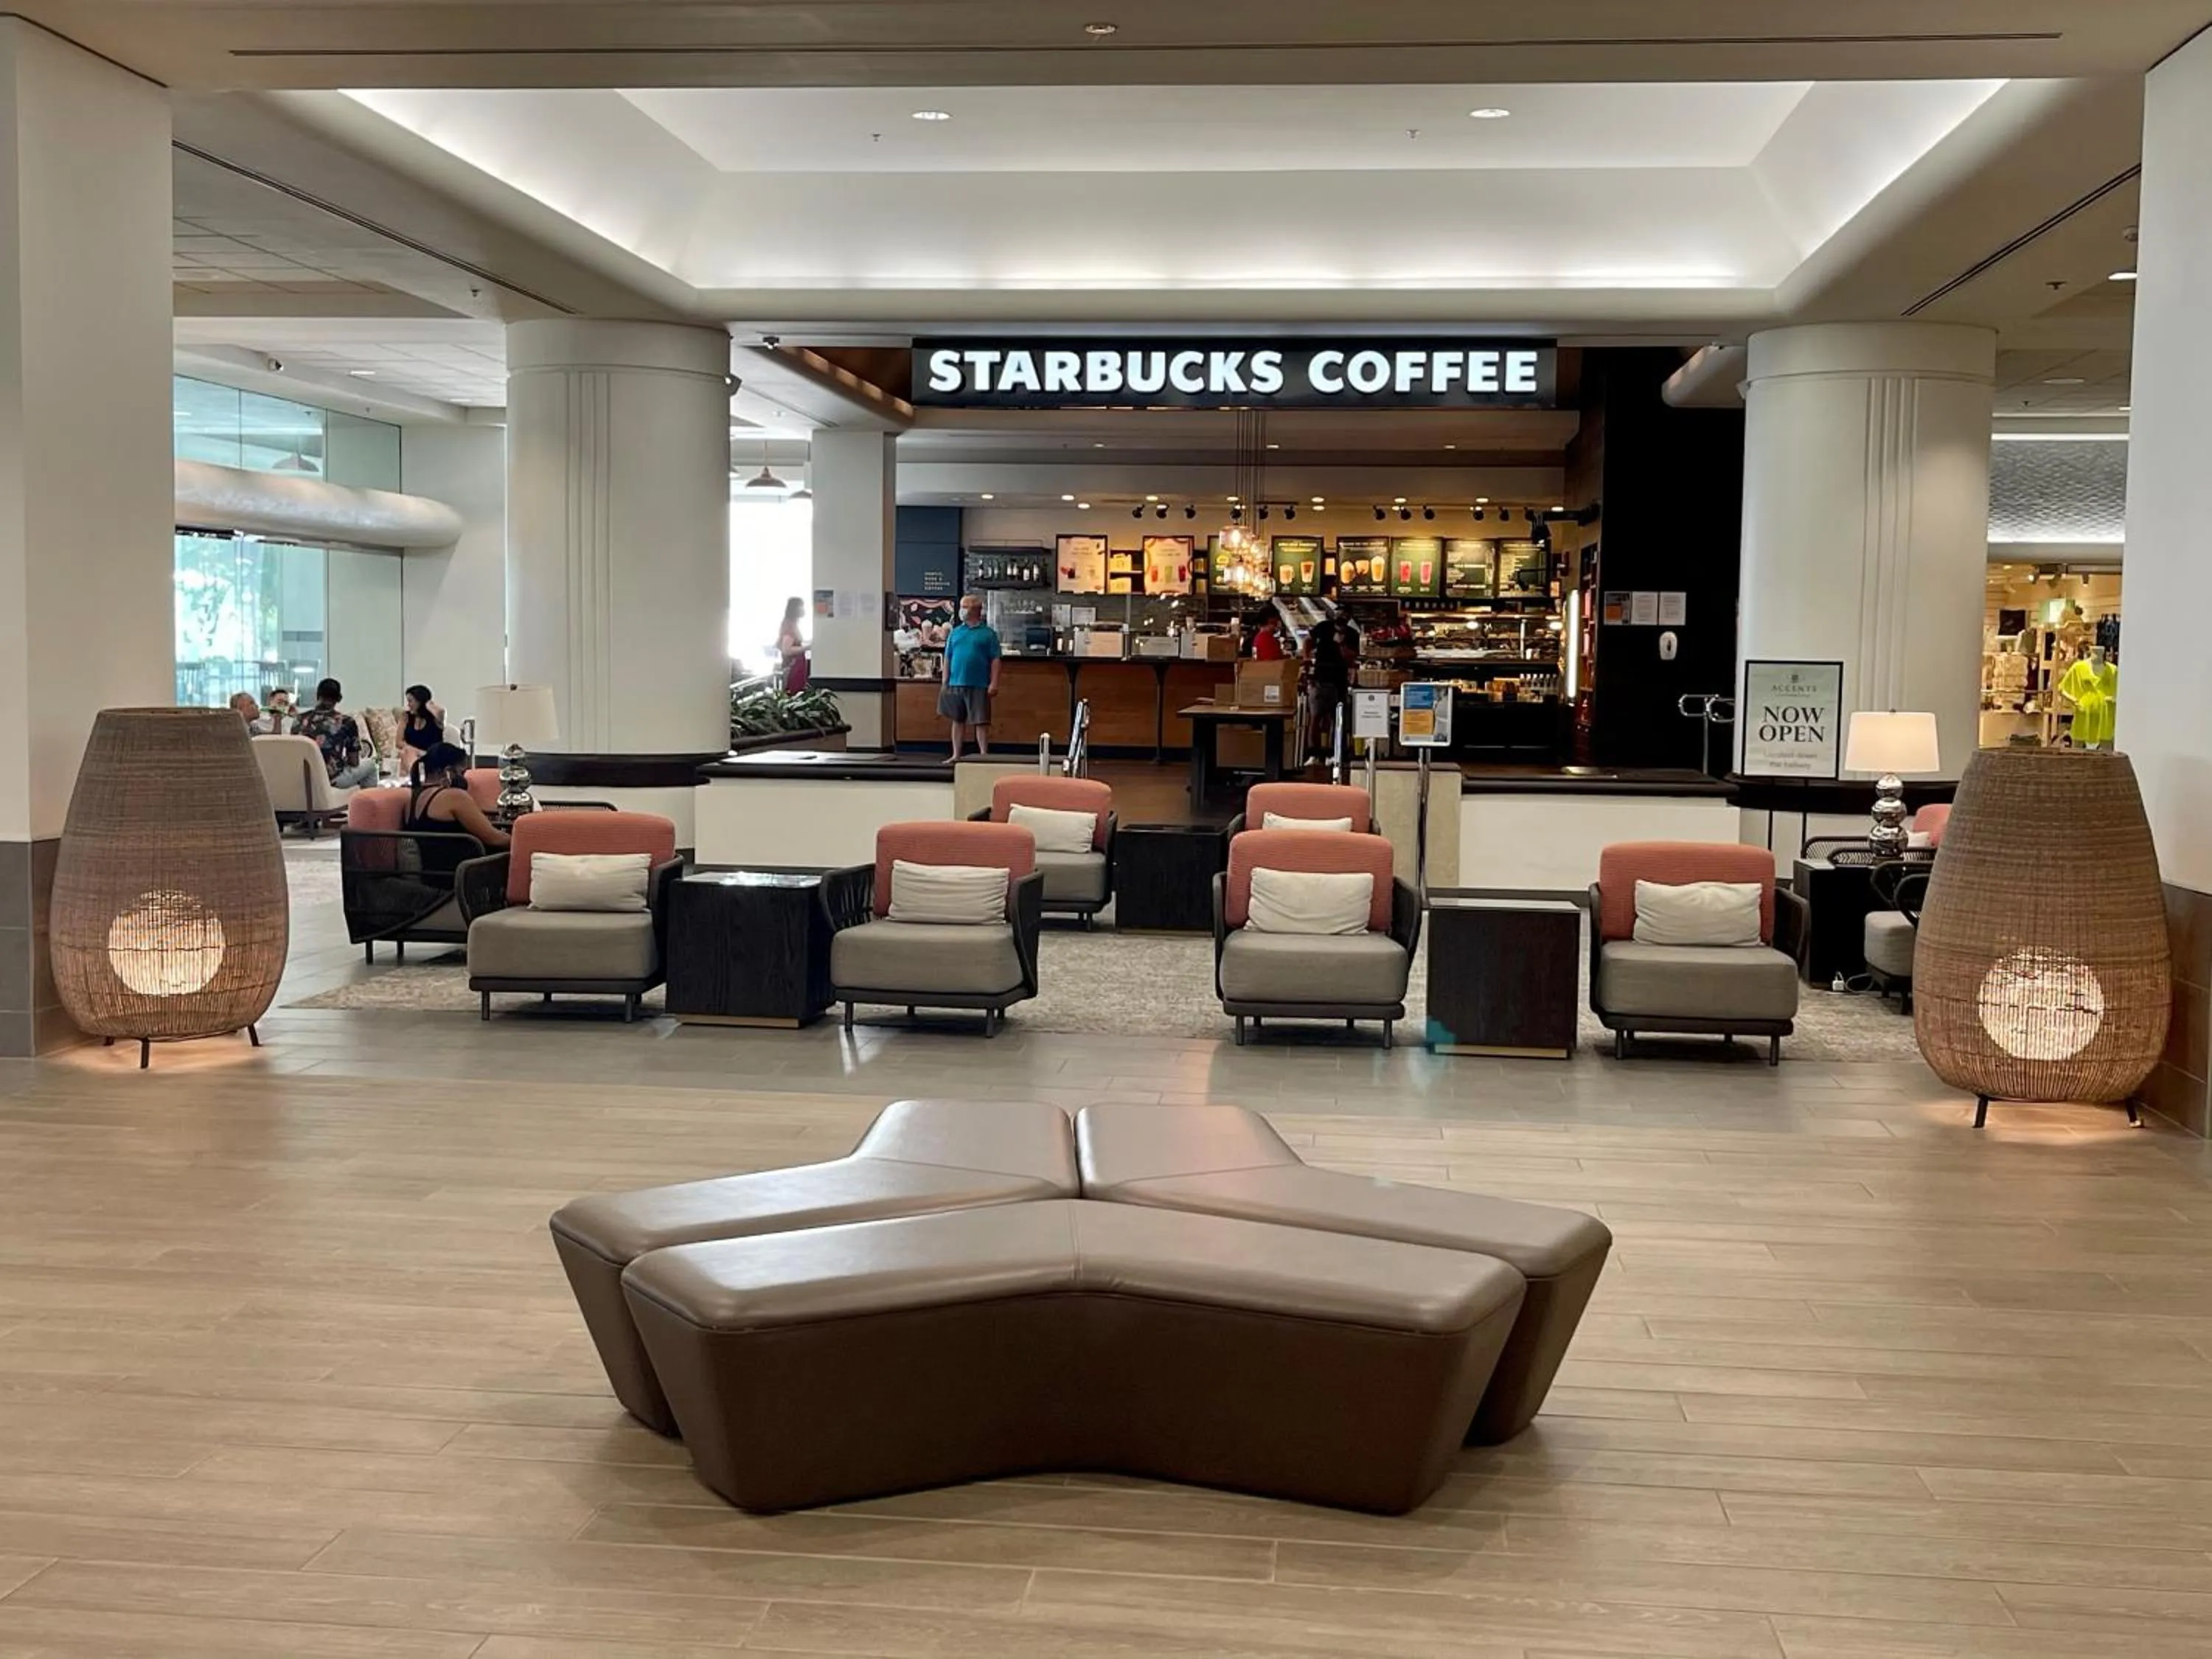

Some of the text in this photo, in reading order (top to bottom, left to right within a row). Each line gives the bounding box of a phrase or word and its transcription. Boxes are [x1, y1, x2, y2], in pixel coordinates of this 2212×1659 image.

[928, 349, 1538, 393] STARBUCKS COFFEE
[1762, 706, 1825, 723] NOW
[1759, 724, 1825, 742] OPEN
